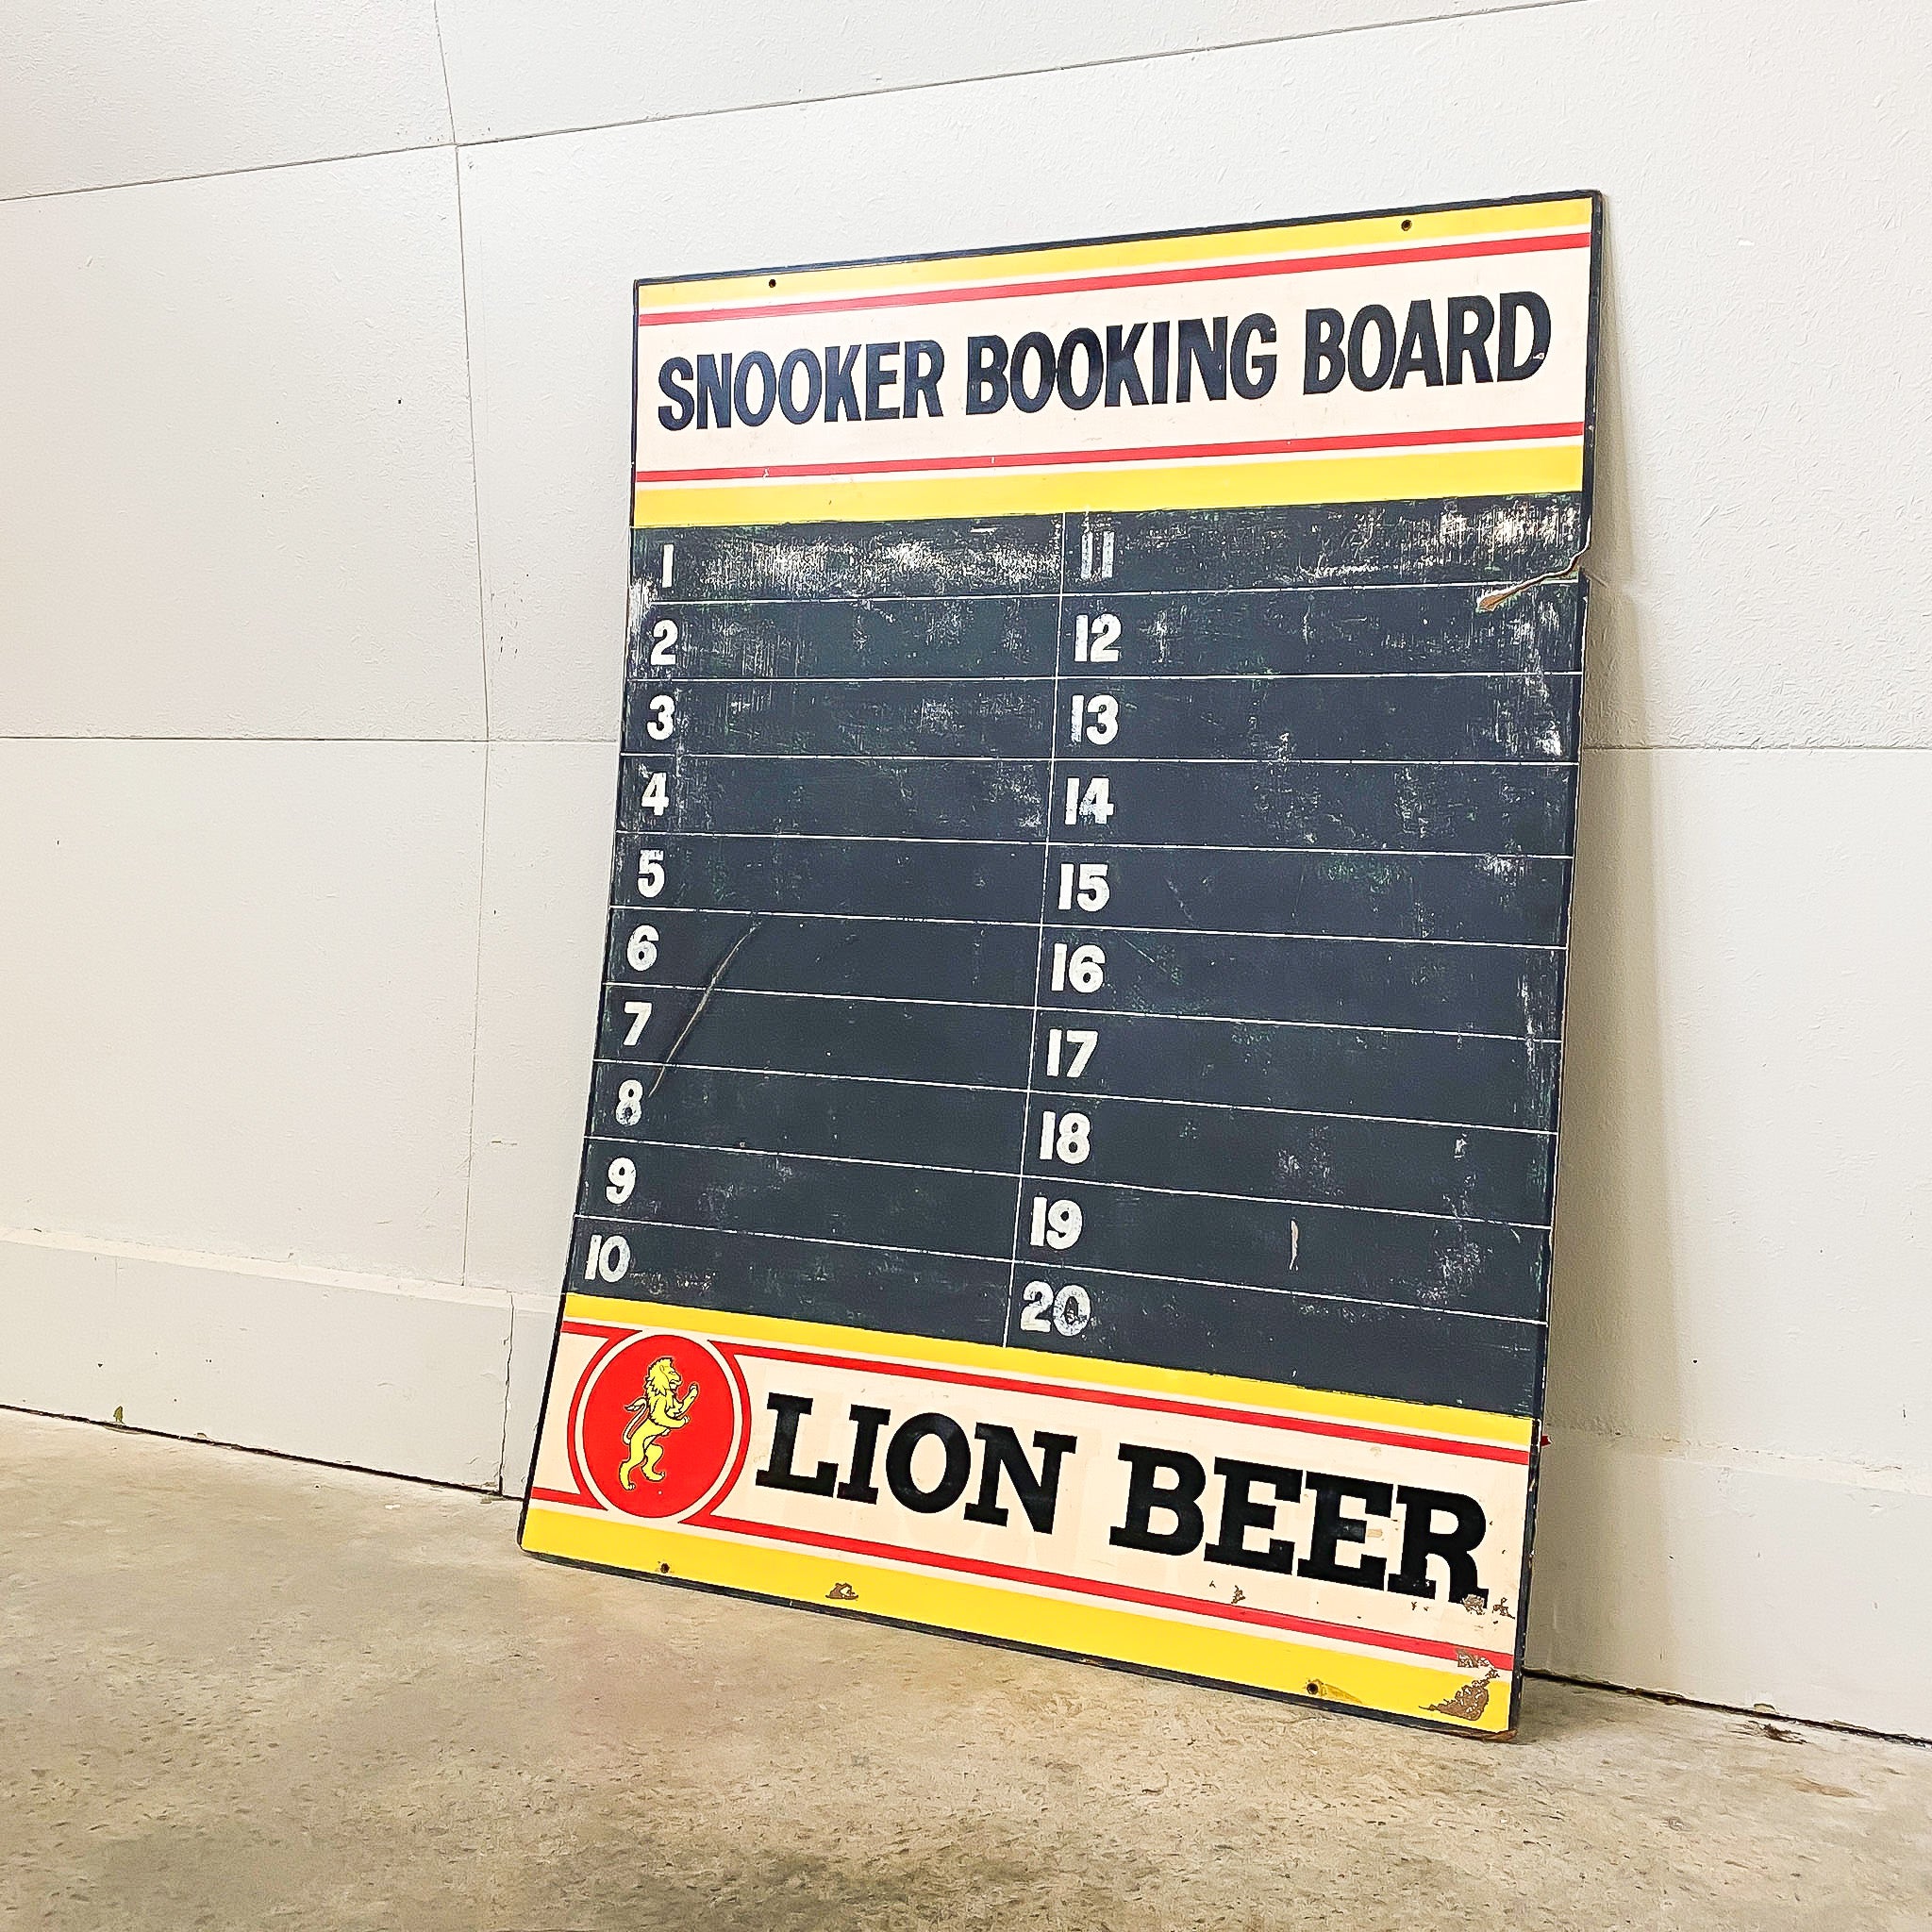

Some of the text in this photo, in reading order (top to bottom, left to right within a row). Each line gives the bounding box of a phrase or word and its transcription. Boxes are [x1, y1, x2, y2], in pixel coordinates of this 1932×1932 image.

[658, 291, 1553, 432] SNOOKER BOOKING BOARD
[661, 544, 674, 588] 1
[1080, 530, 1114, 579] 11
[651, 620, 678, 665] 2
[1074, 613, 1122, 662] 12
[646, 694, 675, 740] 3
[1070, 693, 1119, 745] 13
[641, 773, 670, 815] 4
[1064, 776, 1114, 825] 14
[637, 850, 665, 897] 5
[1058, 863, 1109, 912] 15
[626, 924, 659, 971] 6
[1051, 943, 1106, 993] 16
[623, 1002, 652, 1046] 7
[1046, 1028, 1098, 1077] 17
[615, 1079, 643, 1125] 8
[1039, 1110, 1091, 1164] 18
[605, 1157, 636, 1205] 9
[1030, 1196, 1082, 1250] 19
[584, 1234, 630, 1283] 10
[1020, 1281, 1091, 1337] 20
[756, 1392, 1490, 1609] LION BEER
